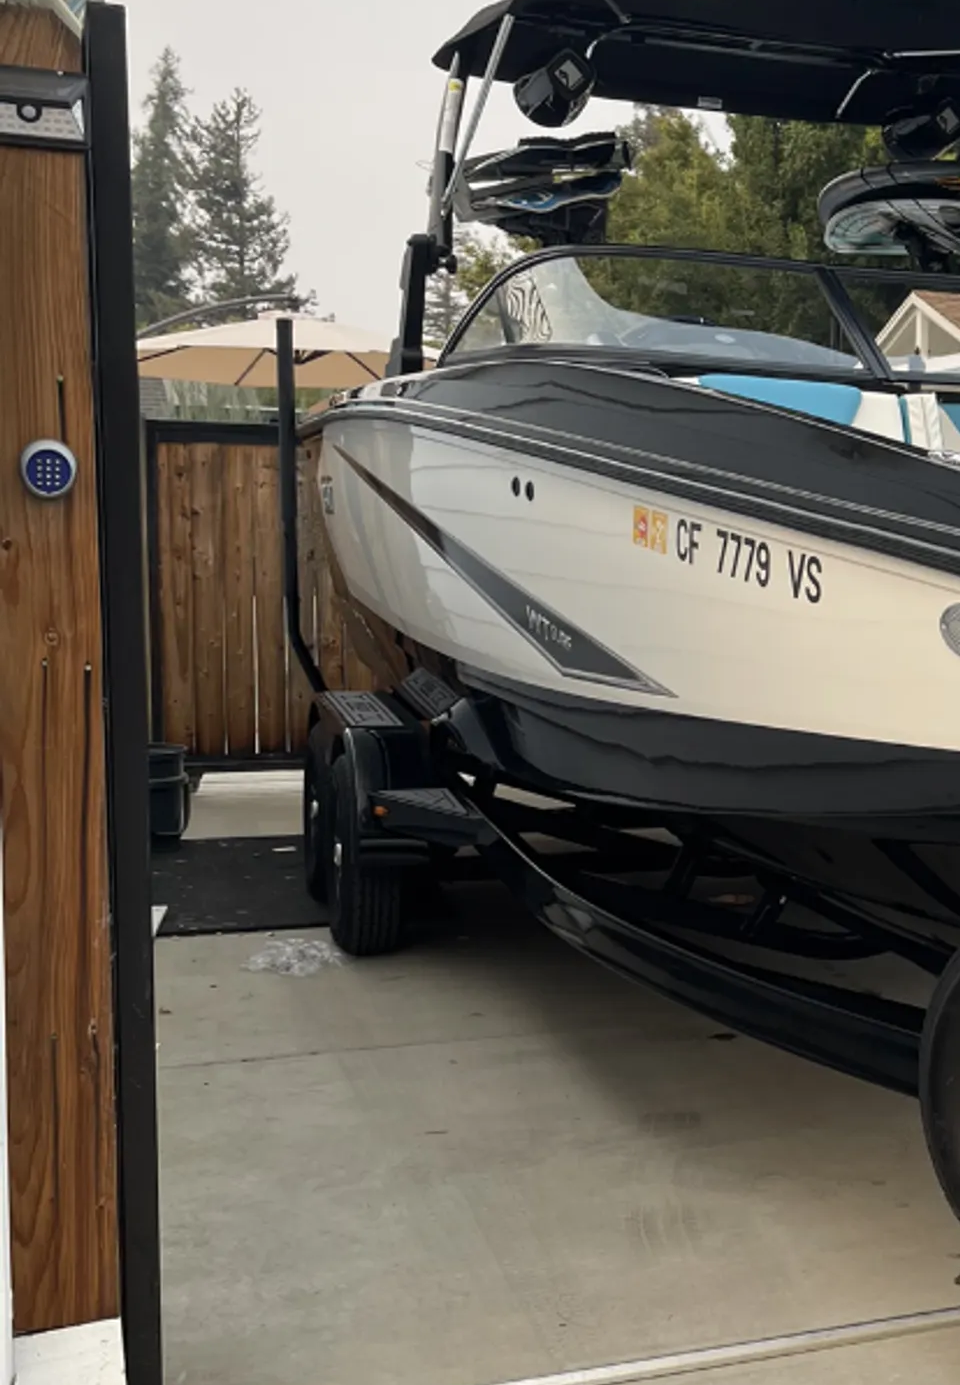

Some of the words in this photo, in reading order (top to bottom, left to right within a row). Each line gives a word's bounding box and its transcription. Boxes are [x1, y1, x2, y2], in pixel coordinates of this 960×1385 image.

[676, 518, 702, 565] CF
[716, 528, 771, 588] 7779
[787, 550, 822, 604] VS
